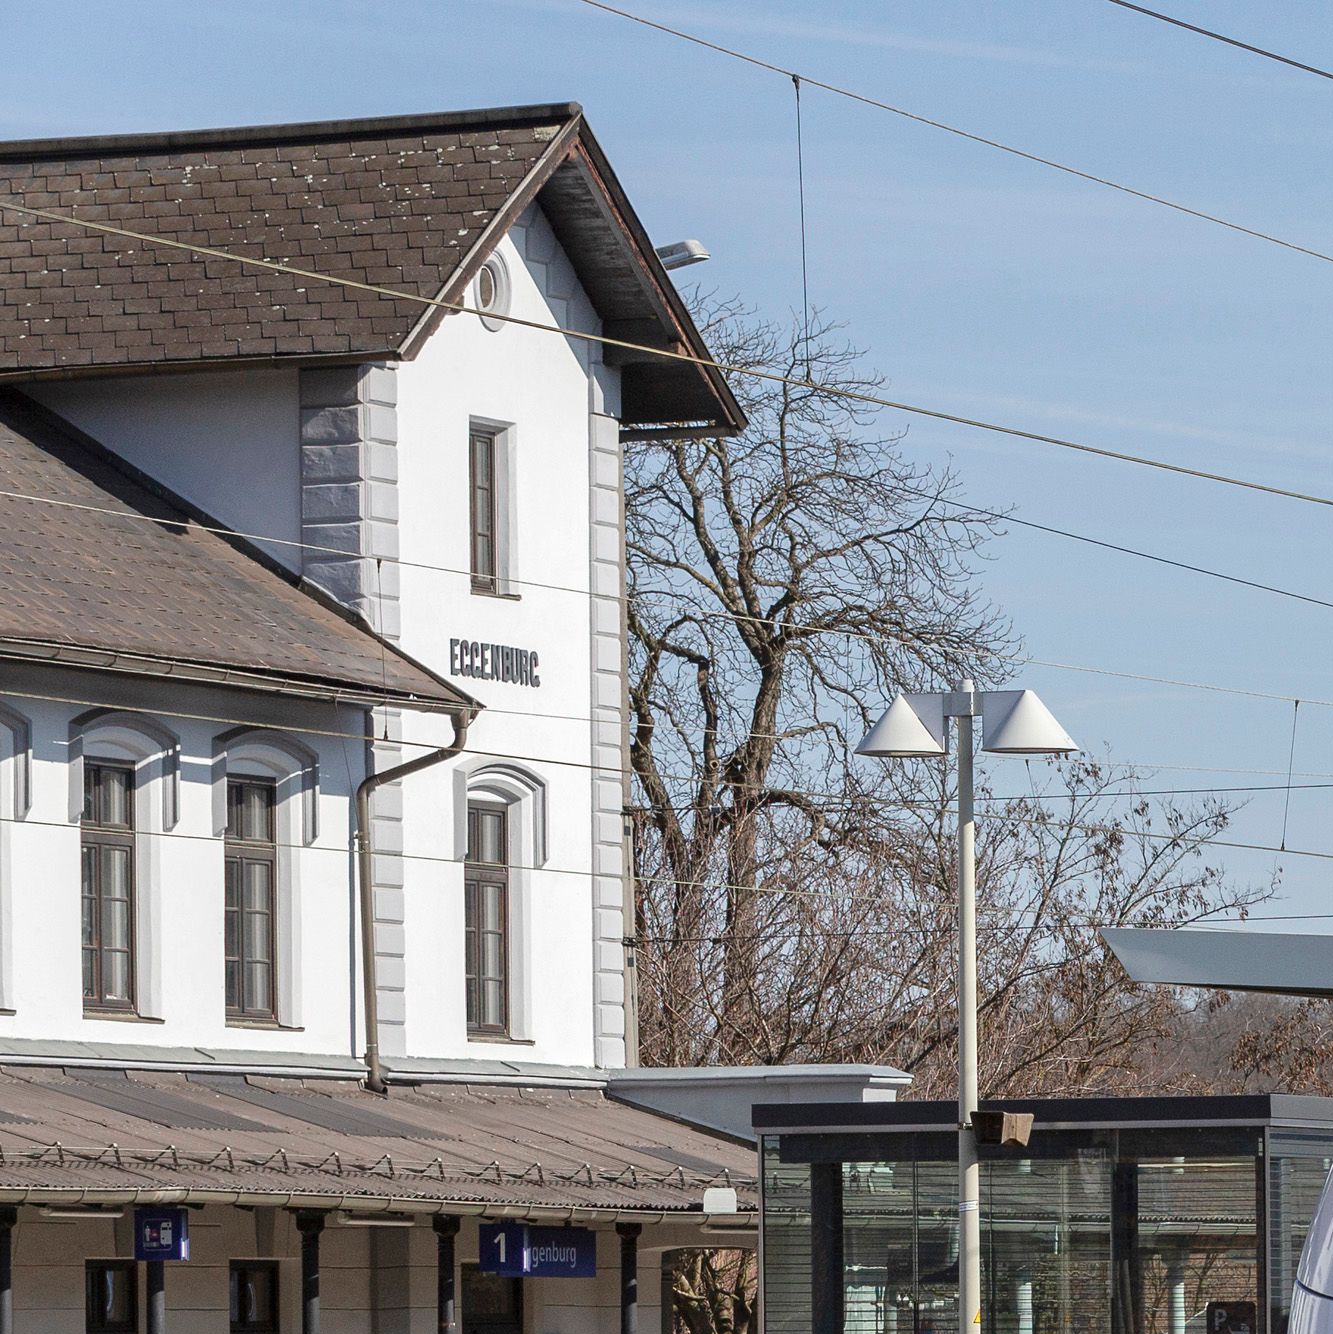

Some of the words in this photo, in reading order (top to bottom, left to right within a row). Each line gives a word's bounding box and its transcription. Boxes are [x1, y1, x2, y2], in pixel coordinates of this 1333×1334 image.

[450, 638, 540, 688] EGGENBURG
[494, 1232, 506, 1263] 1
[531, 1241, 577, 1268] genburg
